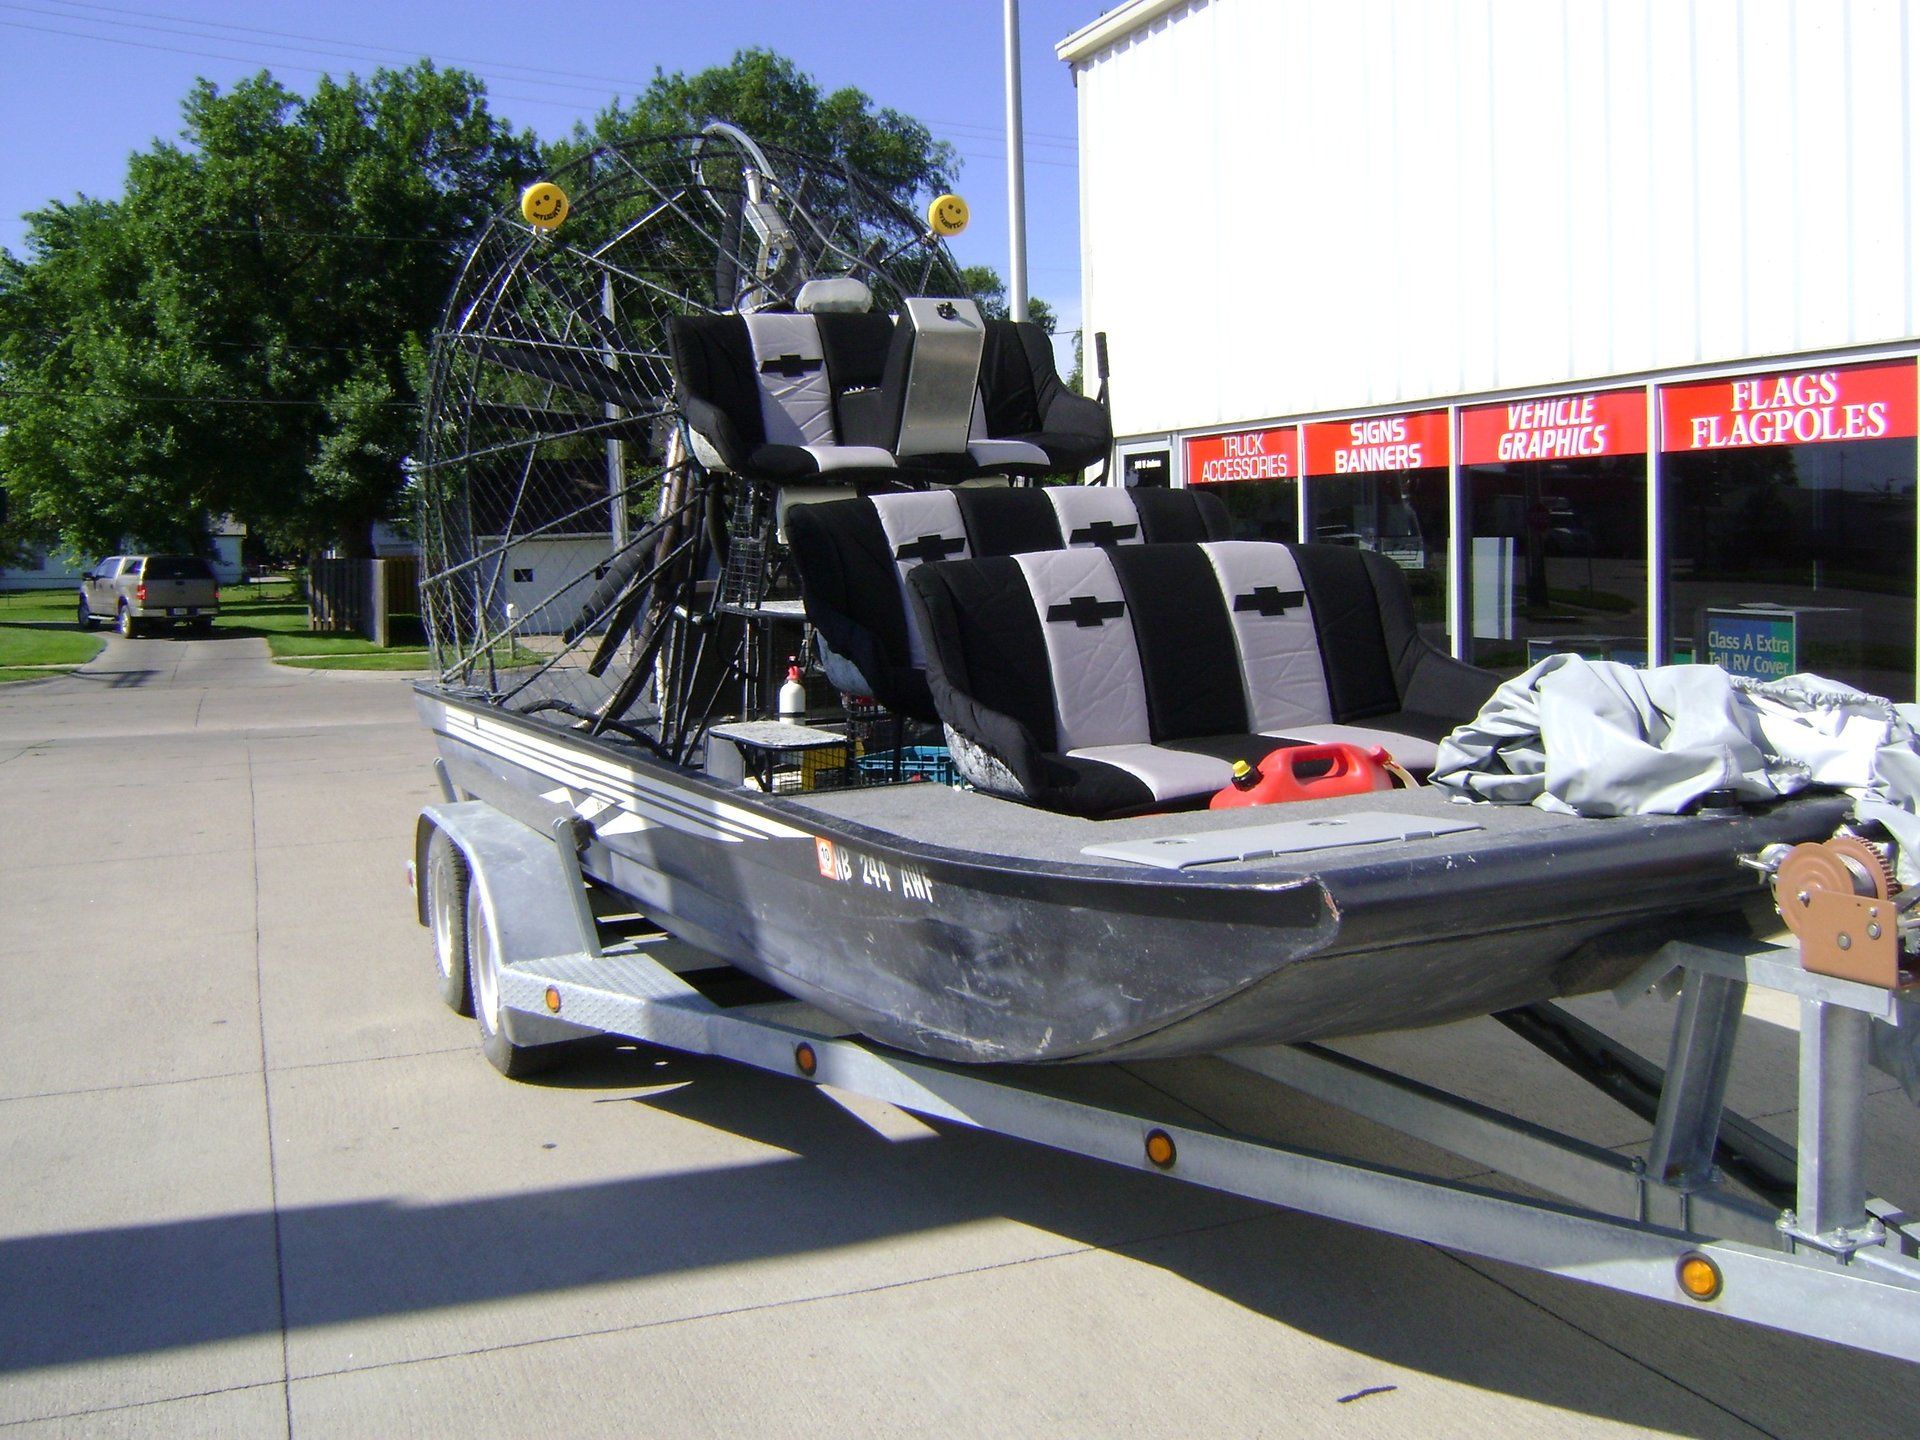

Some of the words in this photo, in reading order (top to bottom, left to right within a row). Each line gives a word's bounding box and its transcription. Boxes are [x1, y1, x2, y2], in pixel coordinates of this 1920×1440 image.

[1731, 372, 1838, 412] FLAGS
[1507, 395, 1595, 430] VEHICLE
[1690, 402, 1887, 449] FLAGPOLES
[1221, 433, 1265, 457] TRUCK
[1350, 418, 1407, 446] SIGNS
[1498, 424, 1606, 461] GRAPHICS
[1202, 453, 1288, 482] ACCESSORIES
[1334, 443, 1422, 474] BANNERS
[1708, 630, 1740, 650] Class
[1743, 634, 1754, 651] A
[1756, 634, 1790, 654] Extra
[1708, 651, 1729, 671] Tall
[1733, 654, 1751, 672] RV
[1753, 655, 1790, 676] Cover
[859, 853, 893, 893] 244
